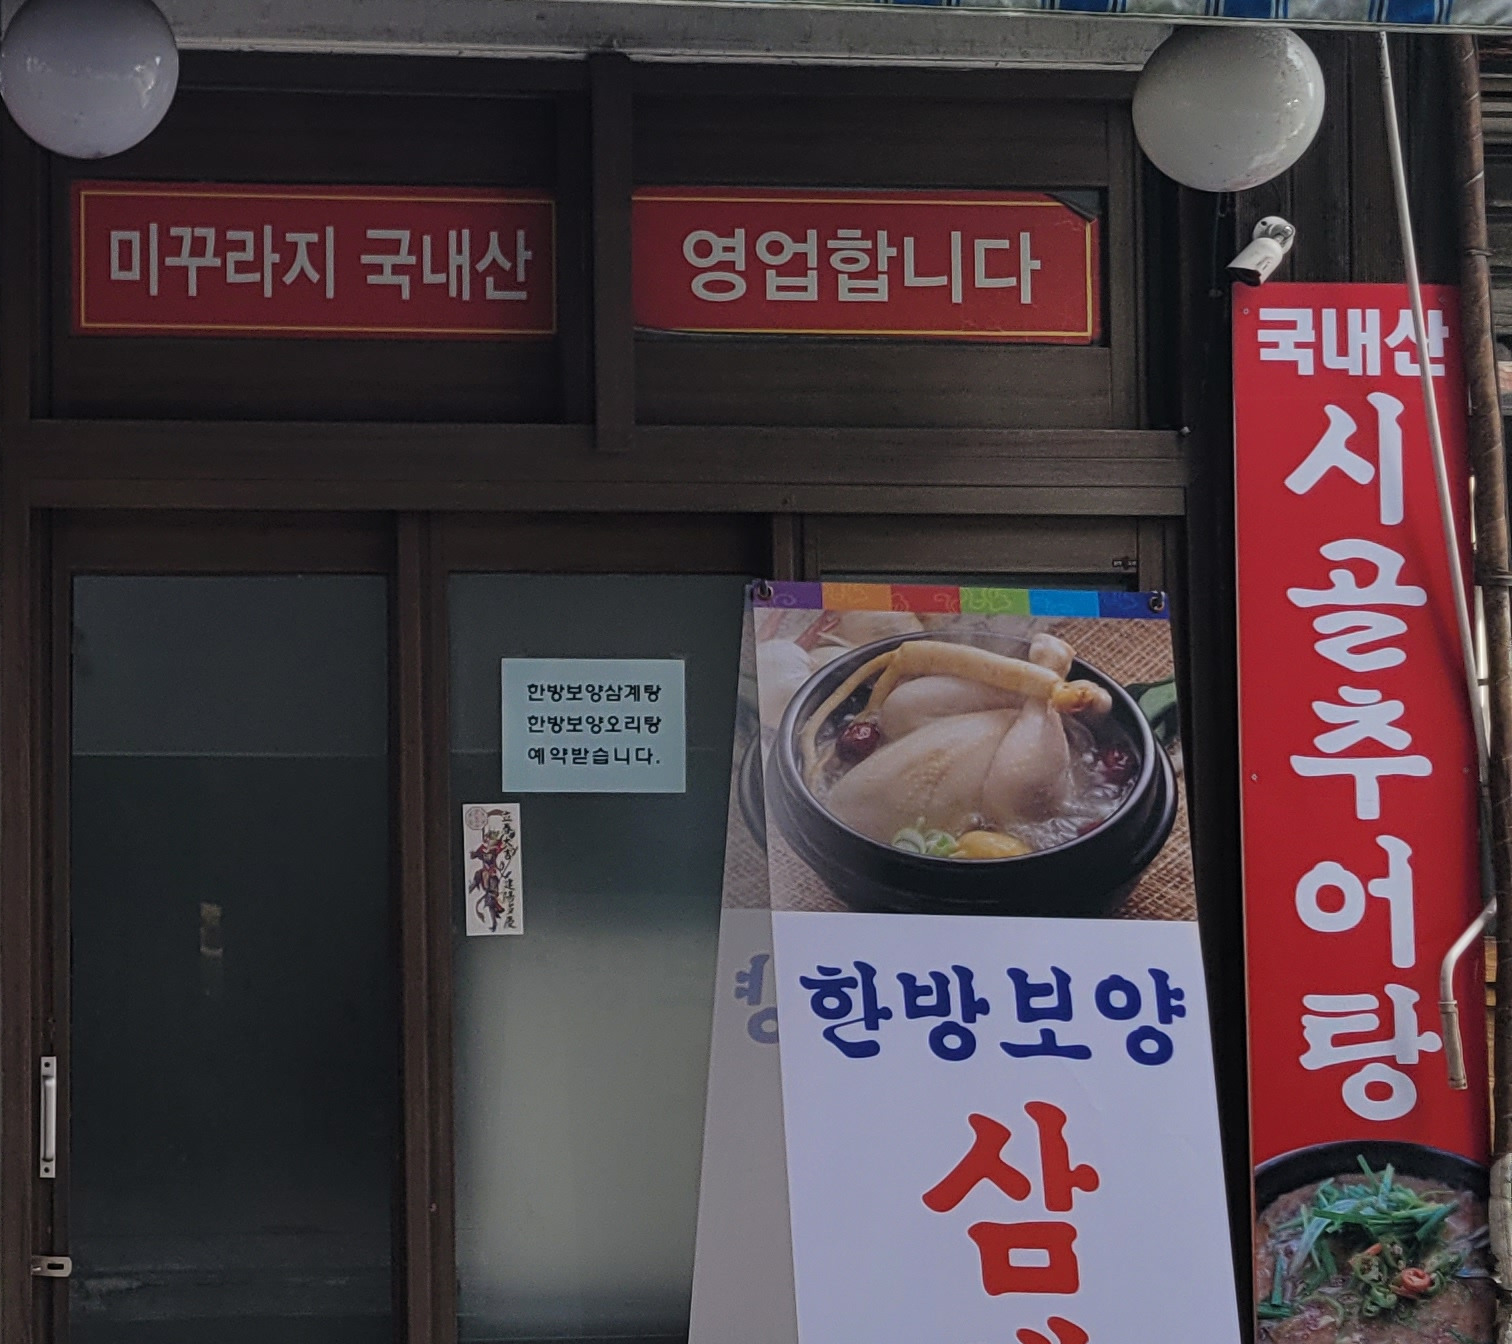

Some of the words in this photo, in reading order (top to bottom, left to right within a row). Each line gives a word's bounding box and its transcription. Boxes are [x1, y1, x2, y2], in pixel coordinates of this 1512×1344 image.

[110, 222, 335, 299] 미꾸라지
[360, 228, 533, 302] 국내산
[682, 228, 1042, 305] 영업합니다
[1257, 308, 1450, 377] 국내산
[527, 683, 662, 703] 한방보양삼계탕
[527, 715, 662, 734] 한방보양오리탕
[527, 746, 660, 766] 예약받습니다.
[799, 960, 1187, 1066] 한방보양
